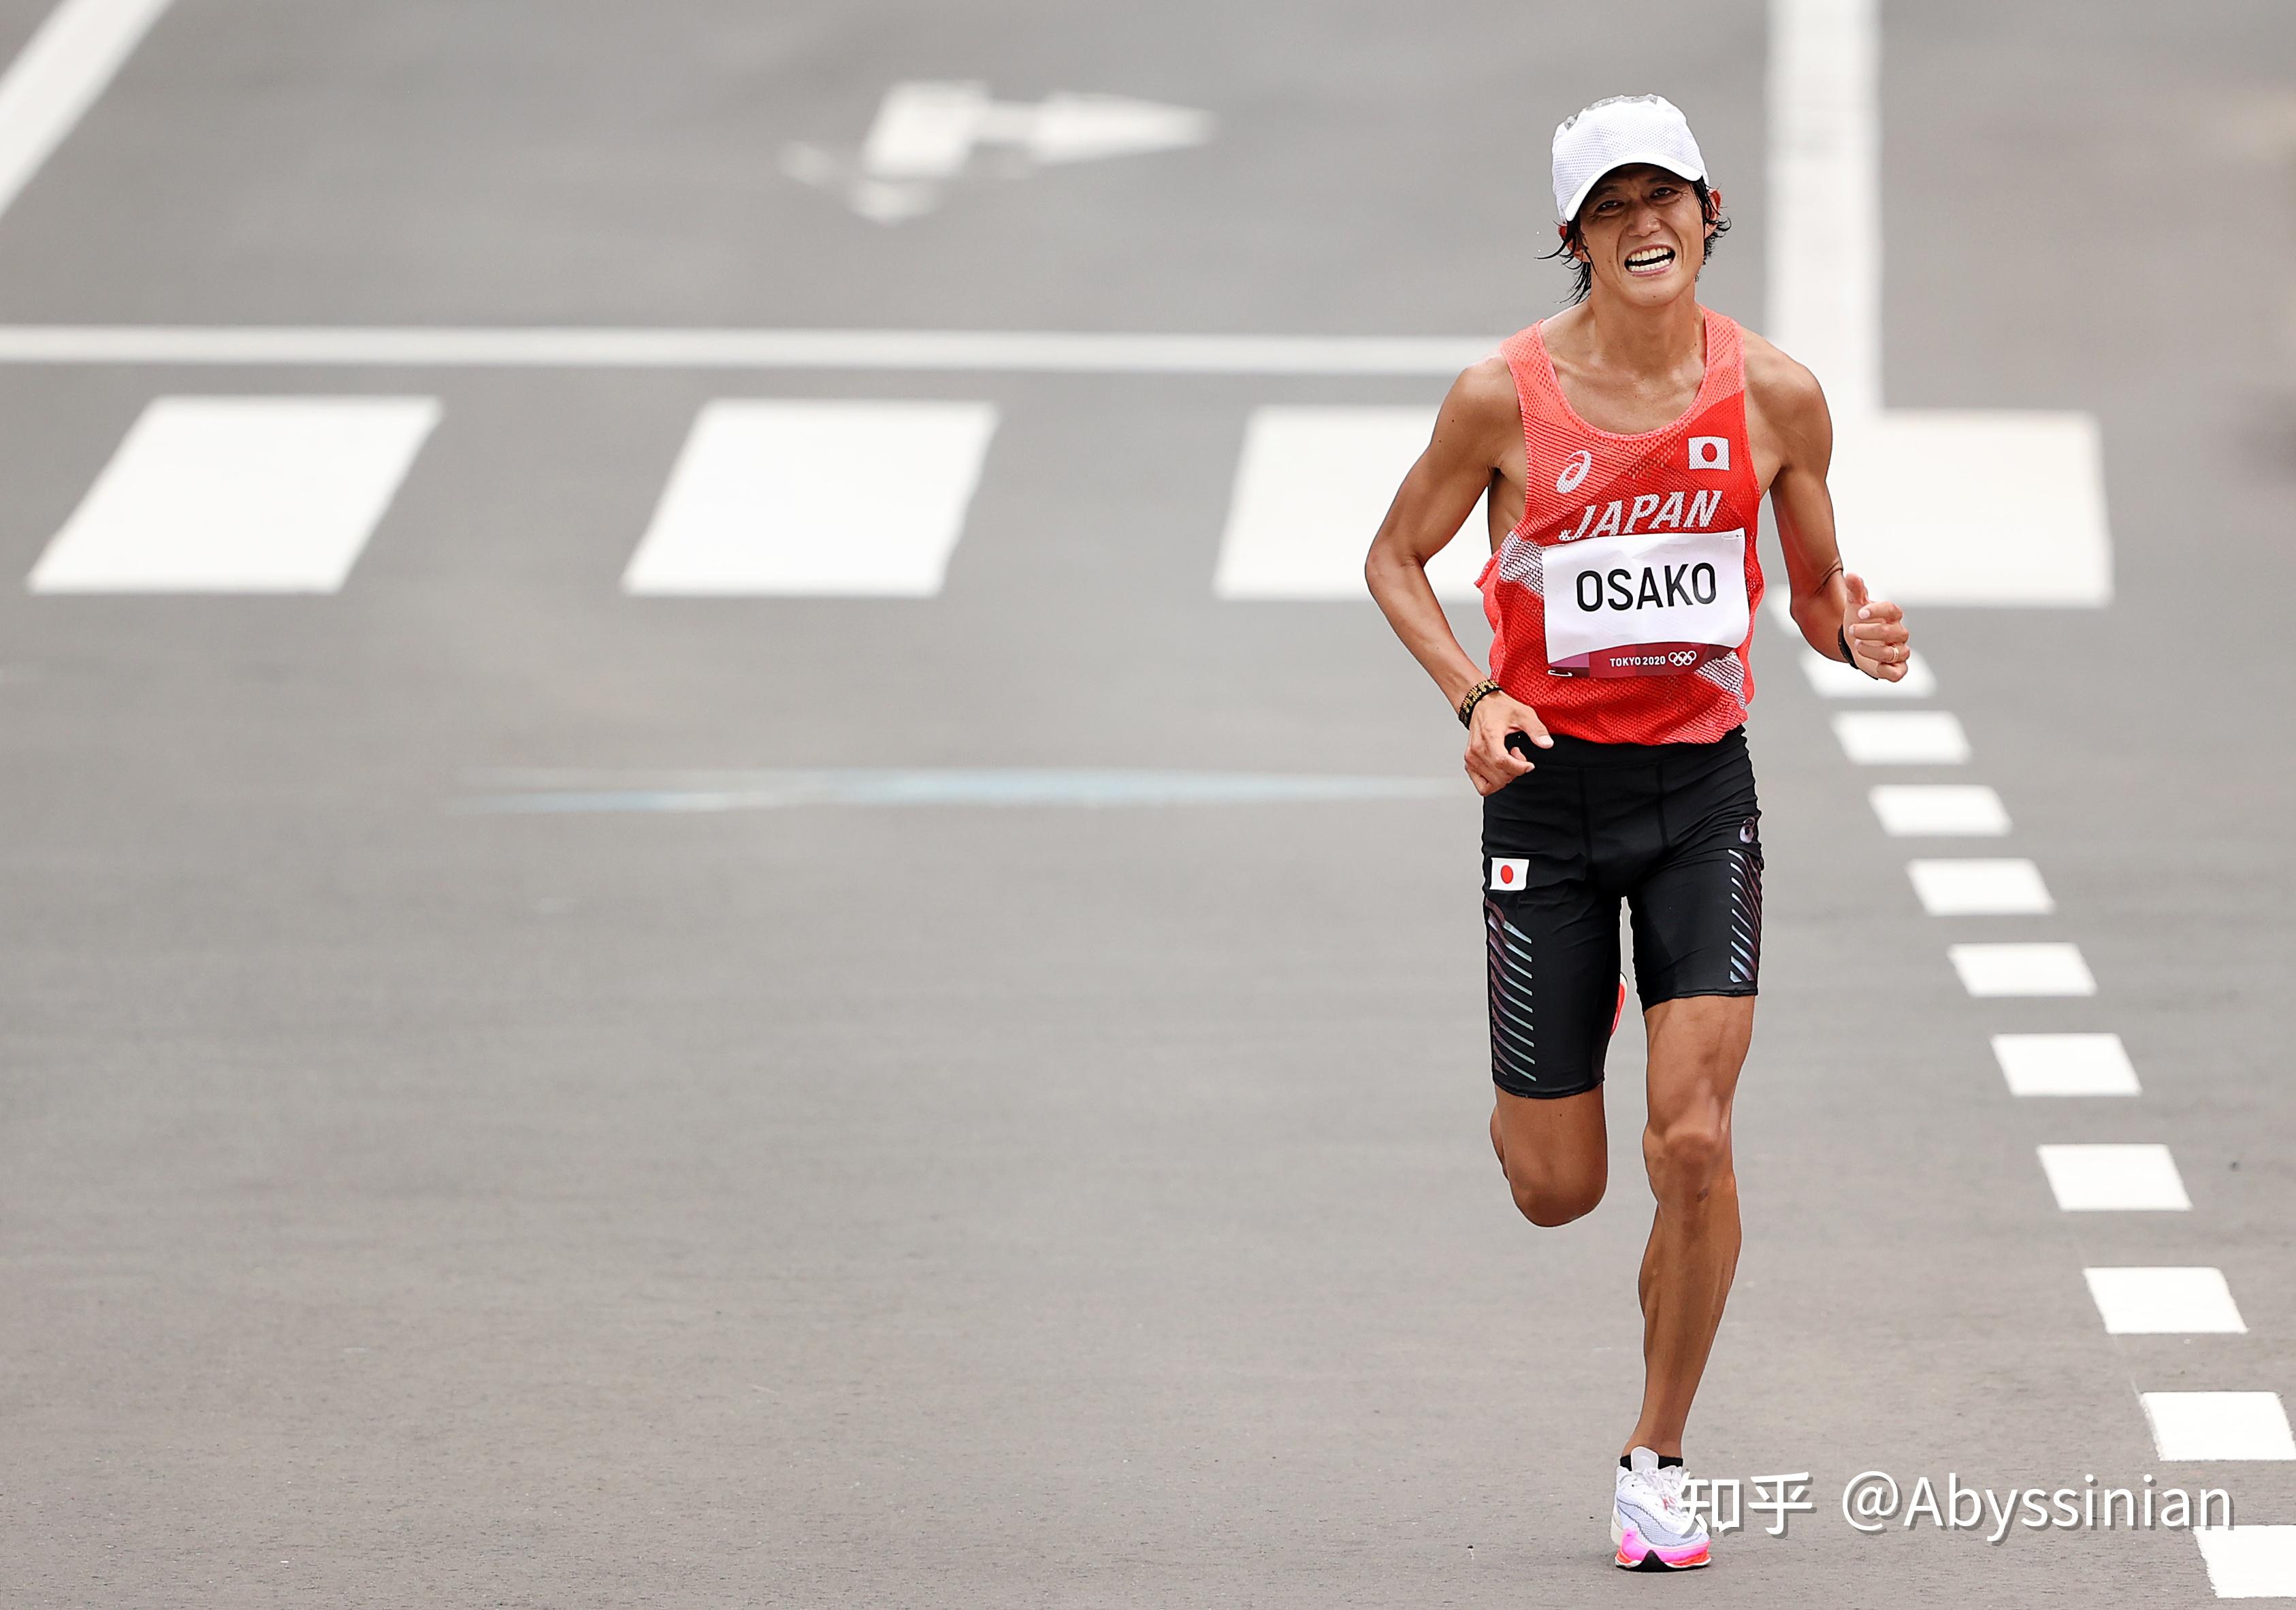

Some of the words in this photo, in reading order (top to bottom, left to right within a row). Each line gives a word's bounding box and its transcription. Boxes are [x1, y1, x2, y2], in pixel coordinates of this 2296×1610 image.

[1559, 490, 1722, 541] JAPAN
[1577, 562, 1717, 612] OSAKO
[1610, 657, 1641, 667] TOKYO
[1643, 656, 1666, 665] 2020
